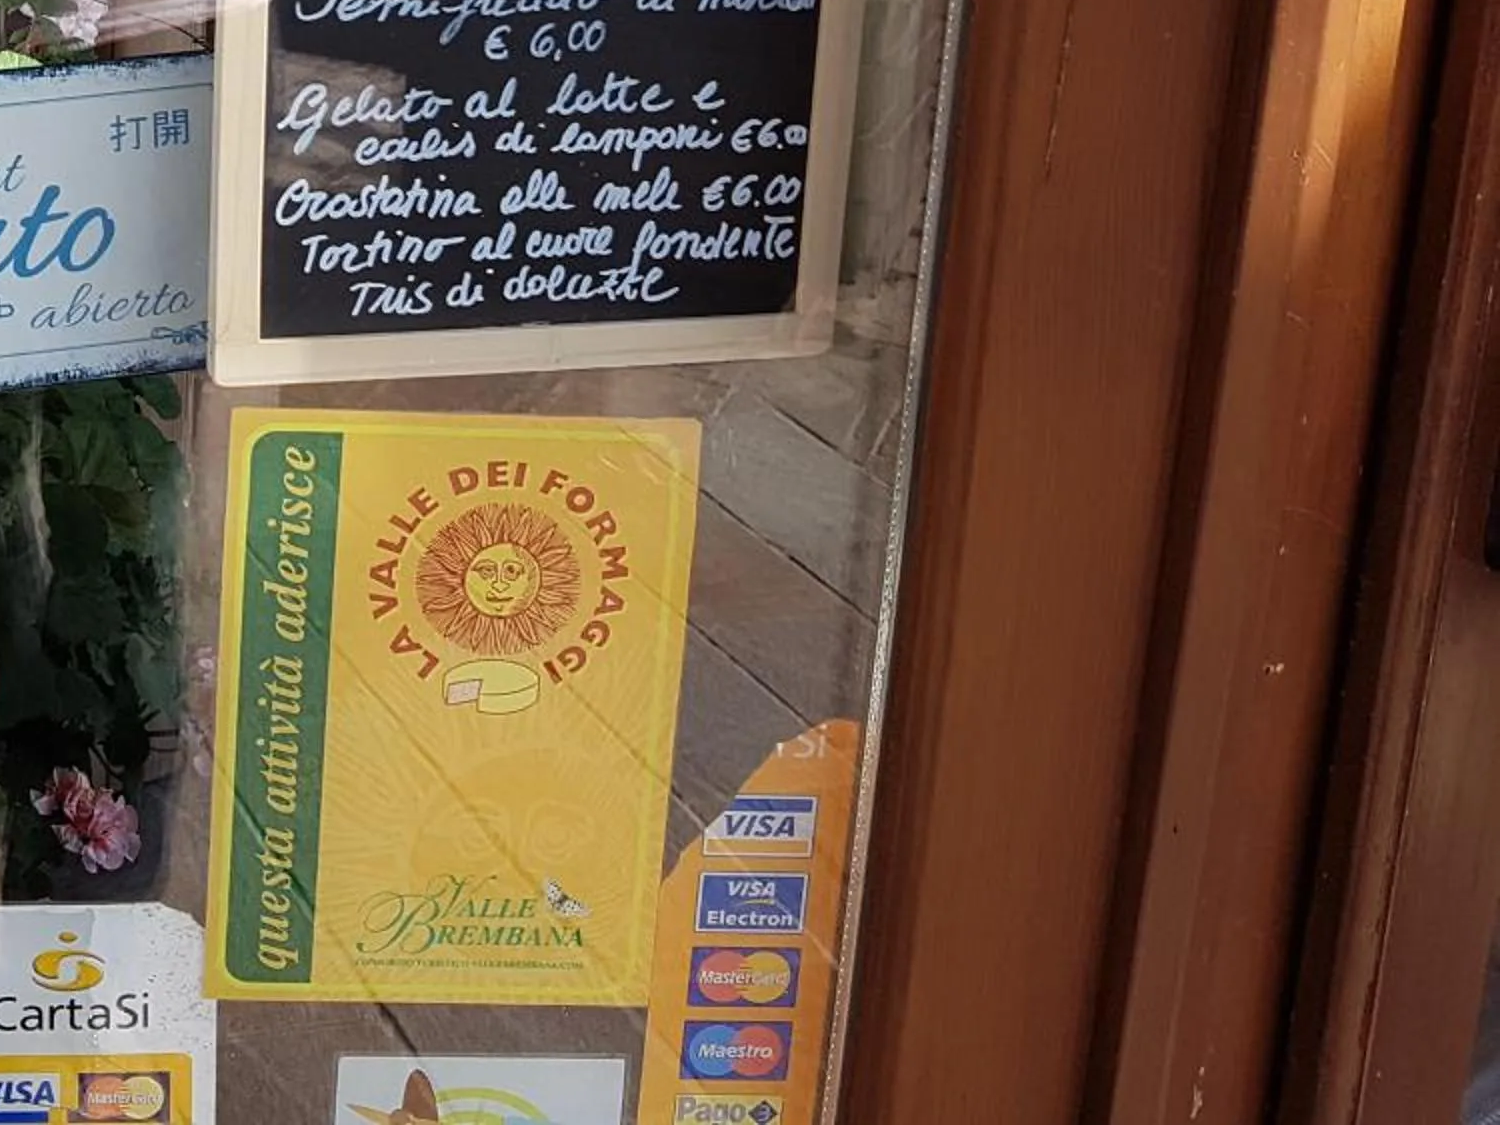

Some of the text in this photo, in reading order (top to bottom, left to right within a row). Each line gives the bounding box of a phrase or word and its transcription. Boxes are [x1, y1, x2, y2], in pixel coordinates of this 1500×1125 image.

[484, 26, 510, 61] €
[110, 108, 191, 153] 打開
[277, 74, 726, 155] Gelato al latte e
[497, 121, 547, 154] di
[550, 117, 722, 171] lamponi
[594, 168, 683, 215] mele
[302, 229, 466, 275] Tortino
[471, 222, 517, 264] al
[29, 282, 196, 332] abierto
[446, 268, 495, 309] di
[367, 460, 631, 686] LA VALLE DEI FORMAGGI
[255, 444, 318, 972] questa attività aderisce
[723, 814, 796, 838] VISA
[727, 880, 777, 898] VISA
[706, 910, 795, 927] Electron
[698, 1044, 774, 1060] Maestro
